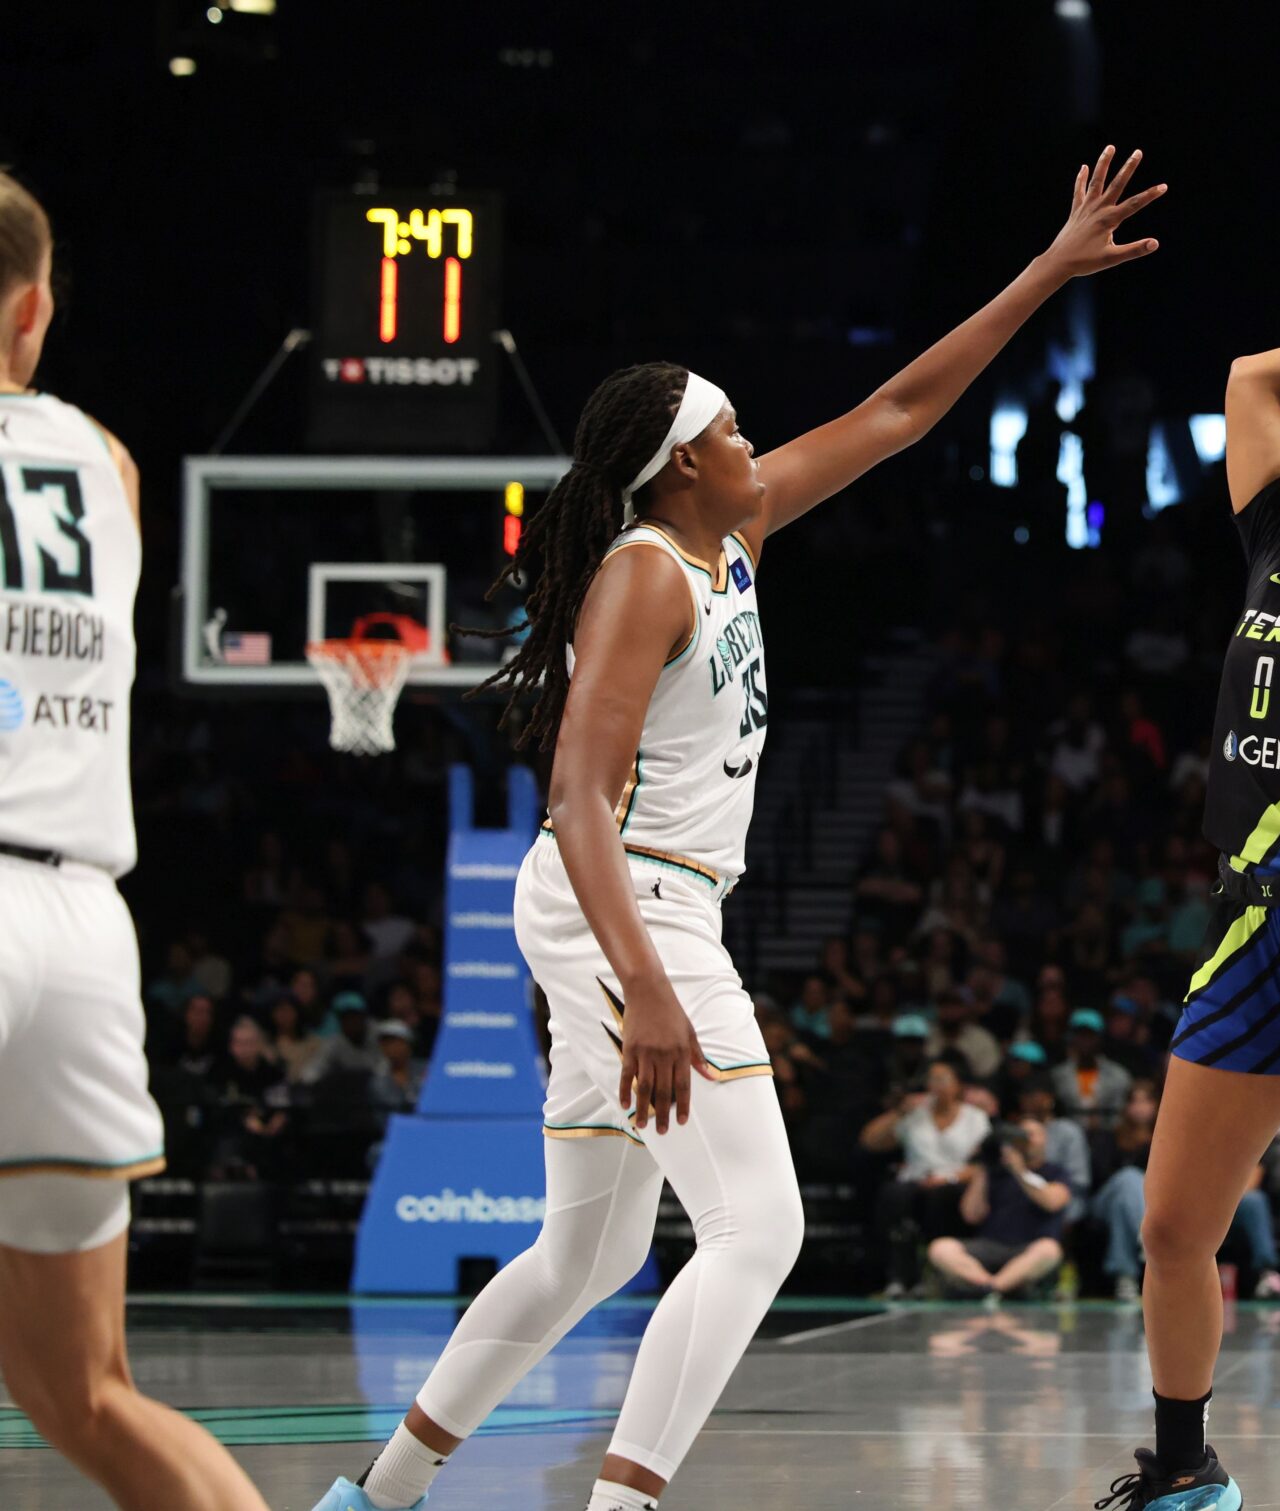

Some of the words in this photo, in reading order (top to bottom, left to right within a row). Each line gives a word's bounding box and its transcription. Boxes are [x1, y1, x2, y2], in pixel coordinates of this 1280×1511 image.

[366, 208, 473, 259] 7:47
[380, 256, 461, 343] 11
[366, 357, 479, 385] TISSOT
[5, 602, 104, 662] FIEBICH
[32, 693, 113, 733] AT&T
[1250, 656, 1274, 719] 0
[450, 911, 514, 929] coinbas
